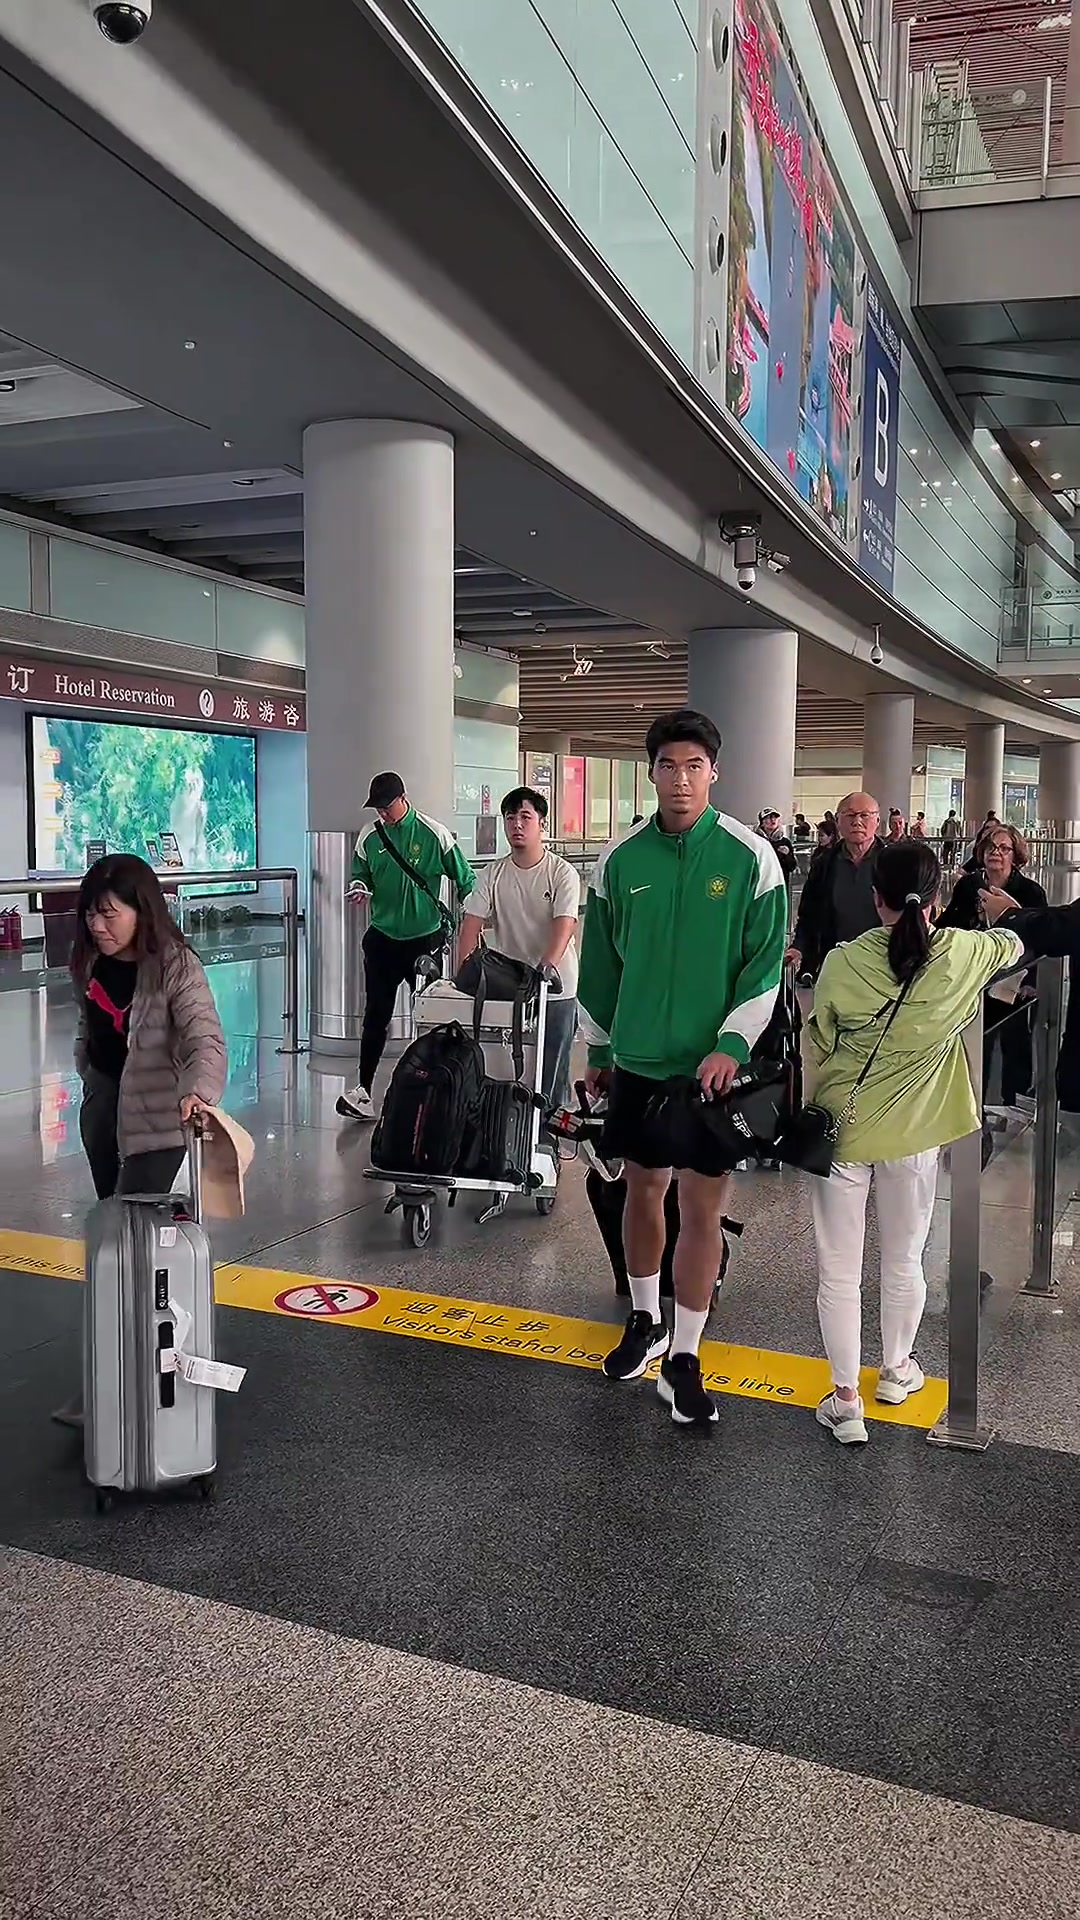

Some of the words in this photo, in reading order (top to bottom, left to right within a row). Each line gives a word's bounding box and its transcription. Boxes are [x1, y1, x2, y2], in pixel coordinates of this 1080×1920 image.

[874, 368, 889, 487] B
[7, 664, 35, 694] 订
[55, 674, 96, 698] Hotel
[100, 680, 176, 708] Reservation
[382, 1315, 477, 1340] Visitors
[480, 1332, 562, 1356] stand
[738, 1376, 796, 1397] line
